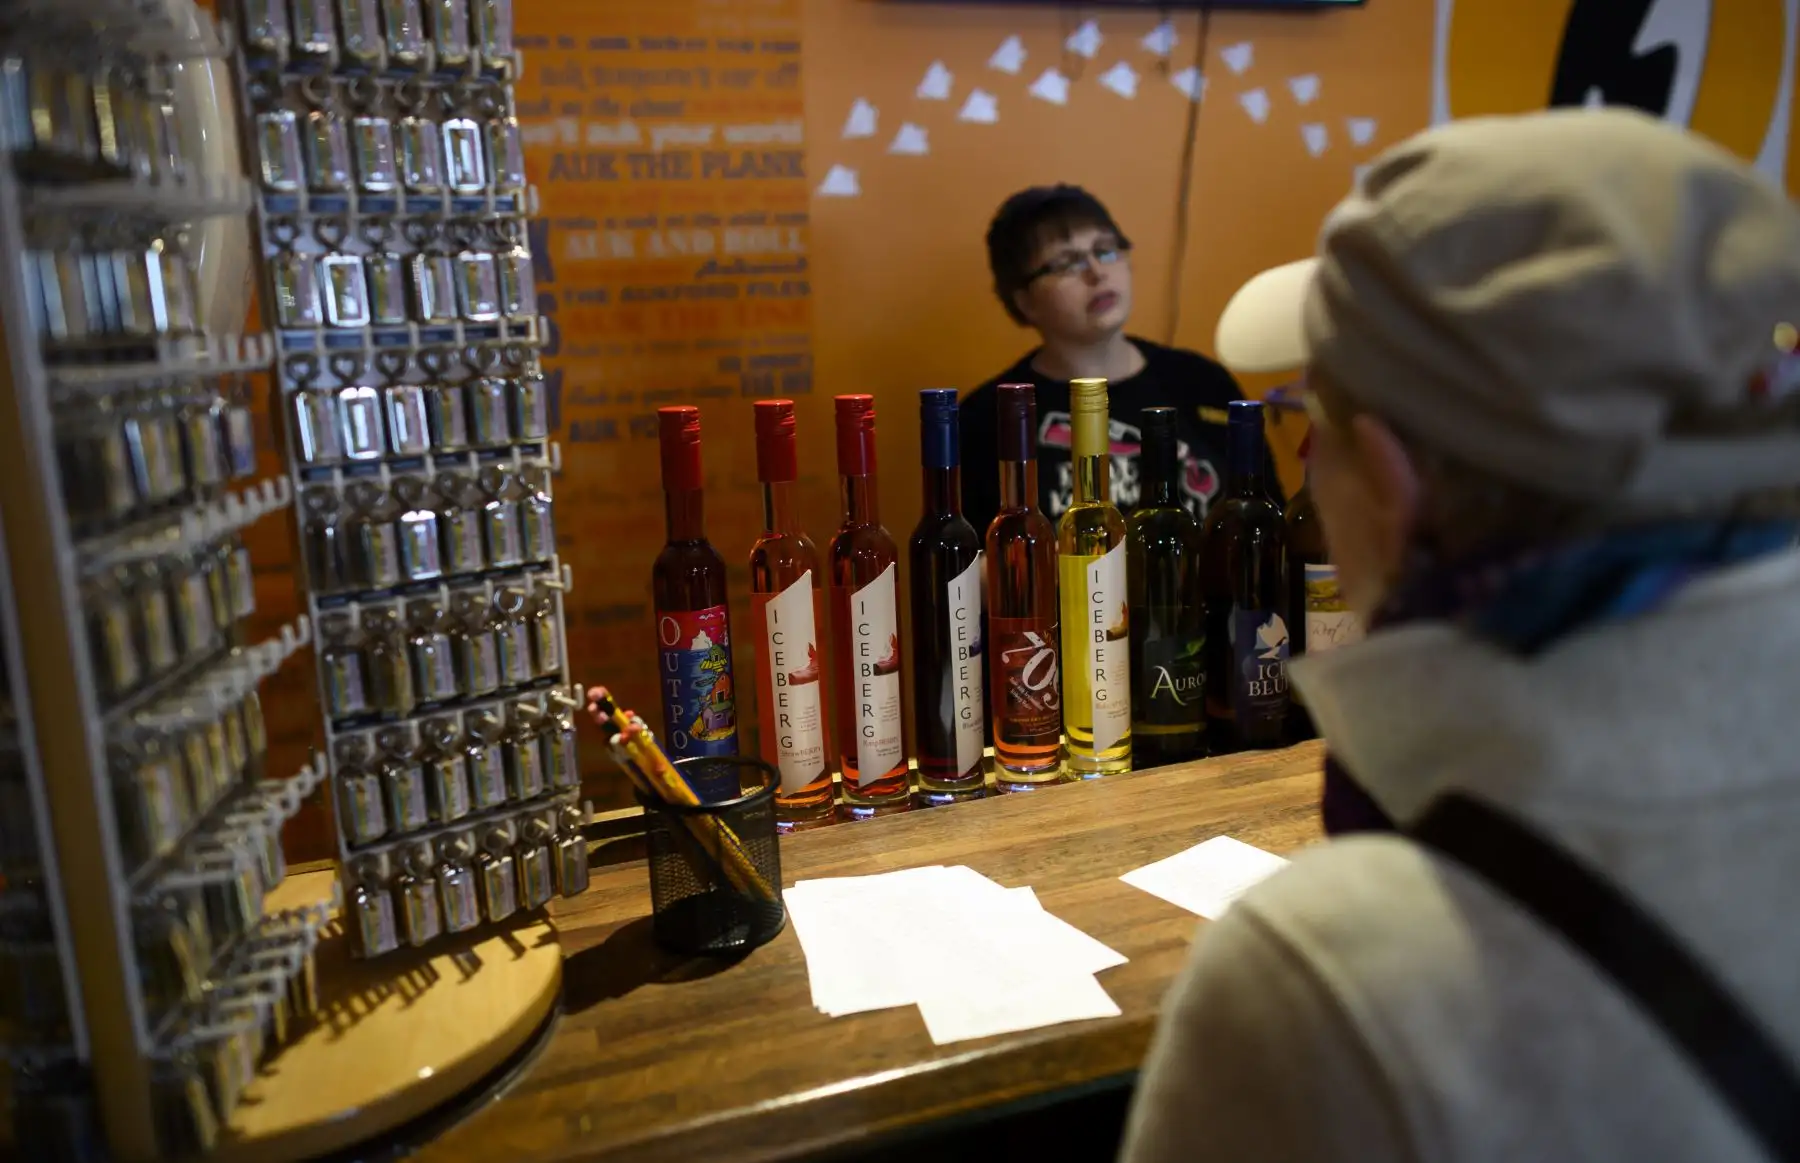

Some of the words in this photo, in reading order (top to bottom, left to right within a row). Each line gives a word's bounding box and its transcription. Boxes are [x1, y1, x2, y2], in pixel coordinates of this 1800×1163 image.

[549, 151, 619, 180] AUK
[626, 152, 693, 179] THE
[702, 150, 805, 179] PLANK
[647, 227, 715, 256] AND
[723, 225, 807, 256] ROLL
[659, 615, 689, 760] OUTPO
[772, 608, 793, 750] ICEBERG
[858, 600, 875, 739] ICEBERG
[955, 586, 972, 720] ICEBERG
[1091, 569, 1108, 702] ICEBERG
